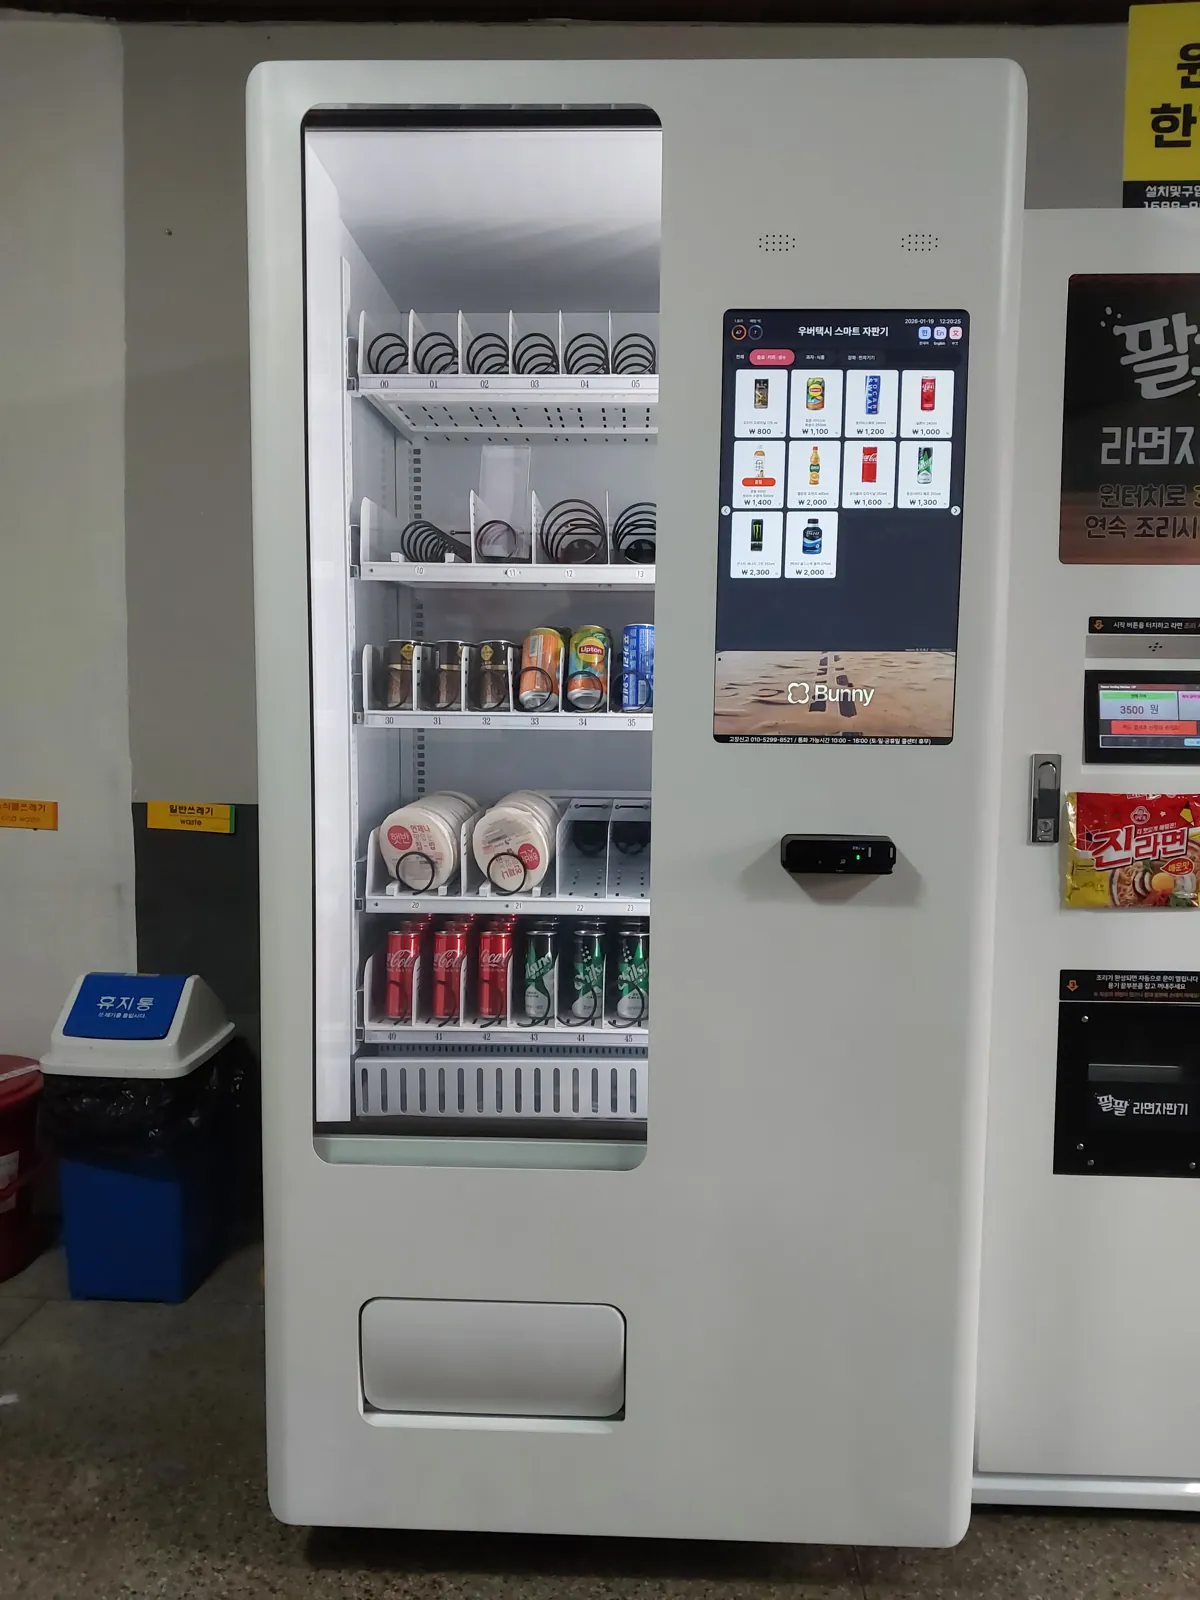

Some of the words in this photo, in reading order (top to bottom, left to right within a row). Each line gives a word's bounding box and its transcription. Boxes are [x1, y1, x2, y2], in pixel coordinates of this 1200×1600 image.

[798, 326, 833, 336] 우버택시
[834, 326, 861, 336] 스마트
[862, 326, 889, 336] 자판기
[936, 329, 945, 337] En
[380, 380, 389, 388] 00
[429, 380, 438, 388] 01
[480, 380, 489, 388] 02
[530, 380, 539, 388] 03
[580, 380, 589, 389] 04
[631, 380, 640, 389] 05
[810, 428, 829, 436] 1,100
[865, 428, 884, 436] 1,200
[920, 428, 940, 436] 1,000
[1099, 483, 1187, 508] 원터치로
[1086, 515, 1127, 539] 연속
[415, 566, 424, 575] 10
[509, 569, 516, 577] 11
[565, 569, 573, 577] 12
[637, 570, 644, 578] 13
[1113, 621, 1125, 629] 시작
[1126, 621, 1144, 629] 버튼을
[1145, 621, 1169, 629] 터치하고
[580, 646, 603, 655] Lipton
[815, 685, 875, 706] Bunny
[1120, 705, 1144, 715] 3500
[1150, 704, 1159, 715] 원
[385, 717, 394, 725] 30
[433, 717, 441, 725] 31
[482, 717, 491, 725] 32
[531, 717, 539, 725] 33
[579, 718, 587, 726] 34
[627, 718, 636, 726] 35
[169, 804, 213, 816] 일반쓰레기
[180, 818, 202, 826] waste
[410, 824, 431, 834] 언제나
[390, 832, 410, 845] 햇반
[1092, 825, 1188, 871] 진라면
[411, 901, 419, 909] 20
[627, 904, 634, 912] 23
[1114, 974, 1138, 982] 완성되면
[1138, 974, 1161, 982] 자동으로
[1175, 975, 1198, 983] 열립니다
[96, 996, 154, 1011] 휴지통
[482, 1033, 491, 1041] 42
[530, 1033, 538, 1041] 43
[577, 1034, 585, 1042] 44
[624, 1034, 633, 1042] 45
[1096, 1094, 1129, 1116] 팔팔
[1132, 1102, 1188, 1116] 라면자판기
